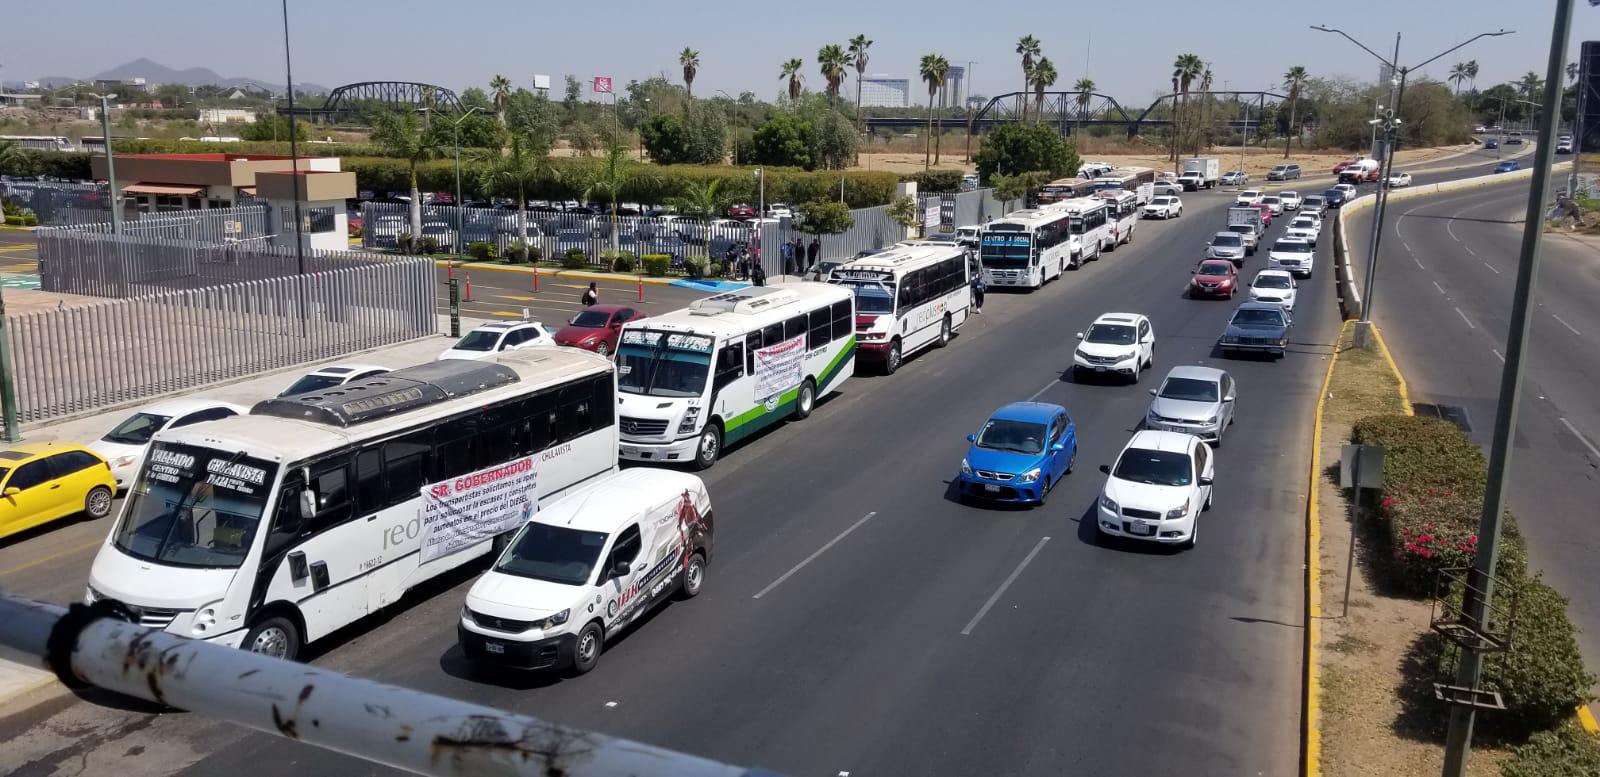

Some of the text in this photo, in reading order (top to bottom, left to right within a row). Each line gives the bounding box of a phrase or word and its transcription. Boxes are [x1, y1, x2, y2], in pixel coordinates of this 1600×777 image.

[151, 449, 195, 469] VALLADO
[152, 464, 180, 475] CENTRO
[426, 503, 437, 512] Los
[483, 479, 515, 496] solicitamos
[431, 458, 533, 500] SR. GOBERNADOR
[424, 514, 438, 527] para
[479, 494, 503, 507] escasez
[508, 482, 537, 497] constantes
[480, 507, 499, 519] precio
[499, 502, 509, 512] del
[509, 494, 528, 508] DIESEL
[383, 508, 420, 550] red
